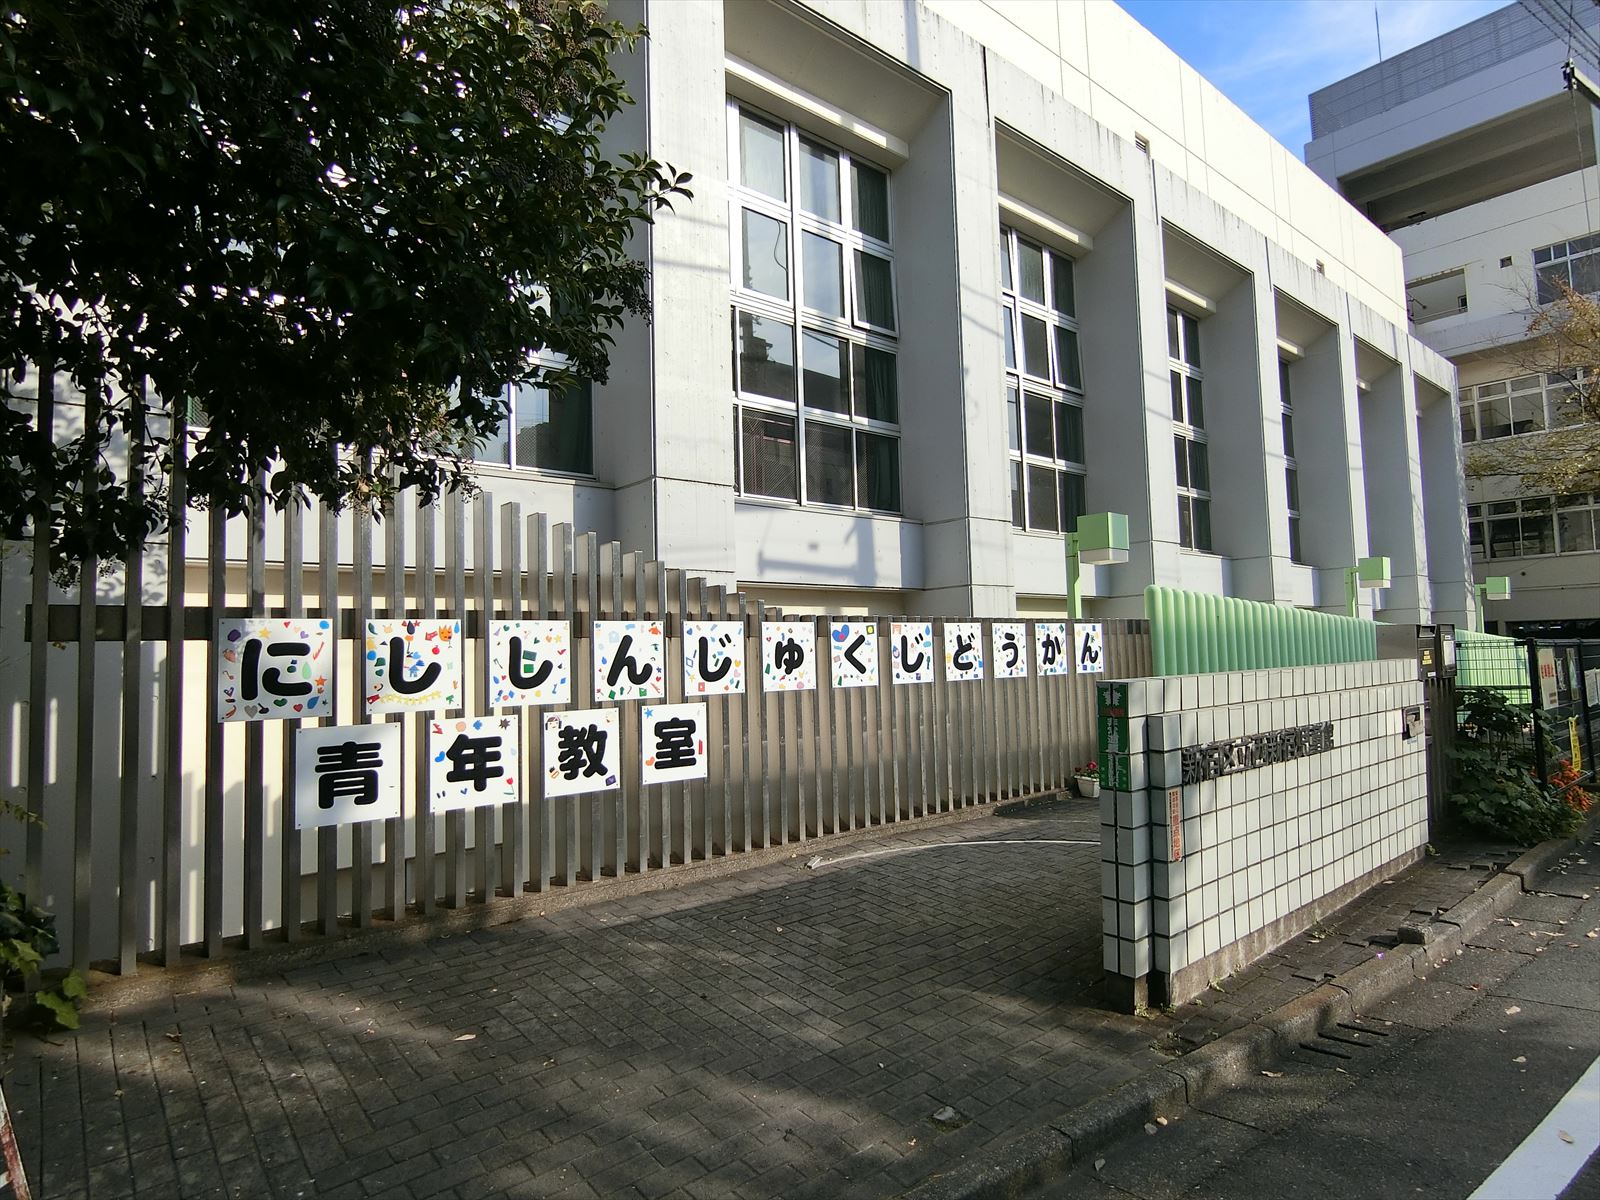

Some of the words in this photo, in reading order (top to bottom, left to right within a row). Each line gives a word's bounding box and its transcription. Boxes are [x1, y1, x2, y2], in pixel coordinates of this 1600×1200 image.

[240, 631, 1100, 701] にししんじゅくじどうかん
[314, 717, 698, 811] 青年教室
